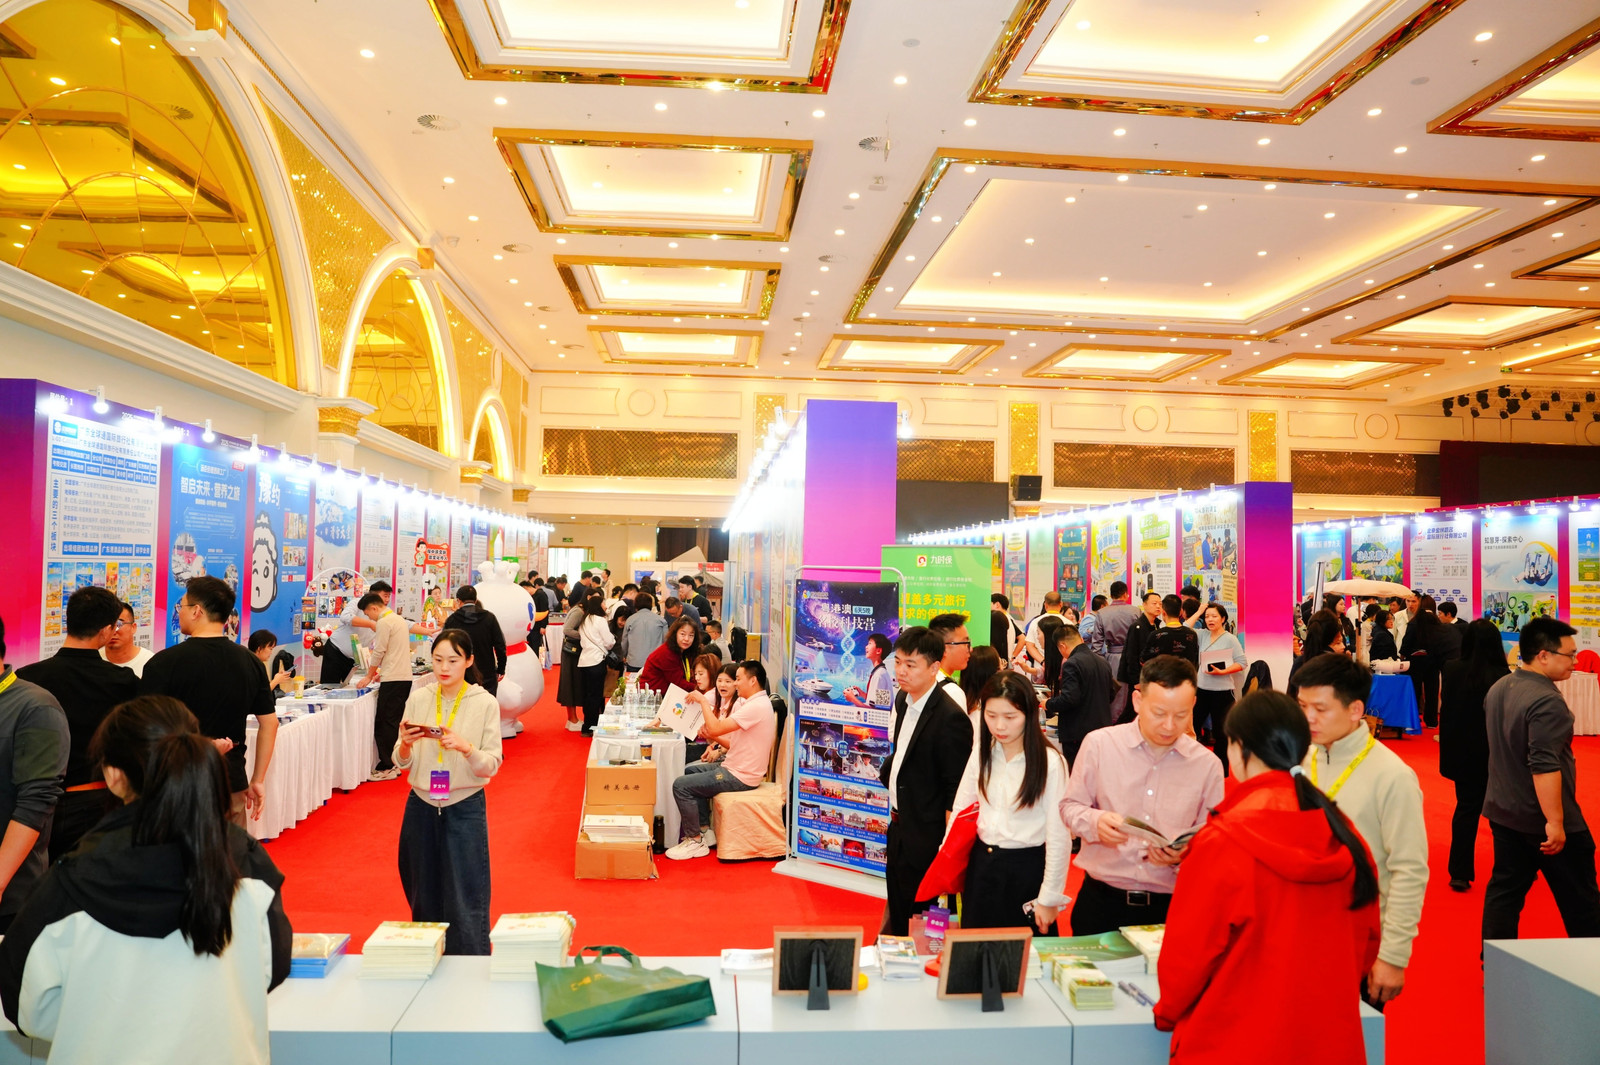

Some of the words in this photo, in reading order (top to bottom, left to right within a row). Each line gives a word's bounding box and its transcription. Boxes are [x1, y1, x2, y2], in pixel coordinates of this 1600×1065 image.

[51, 479, 59, 552] 主要的三个板块
[821, 603, 852, 615] 粤港澳
